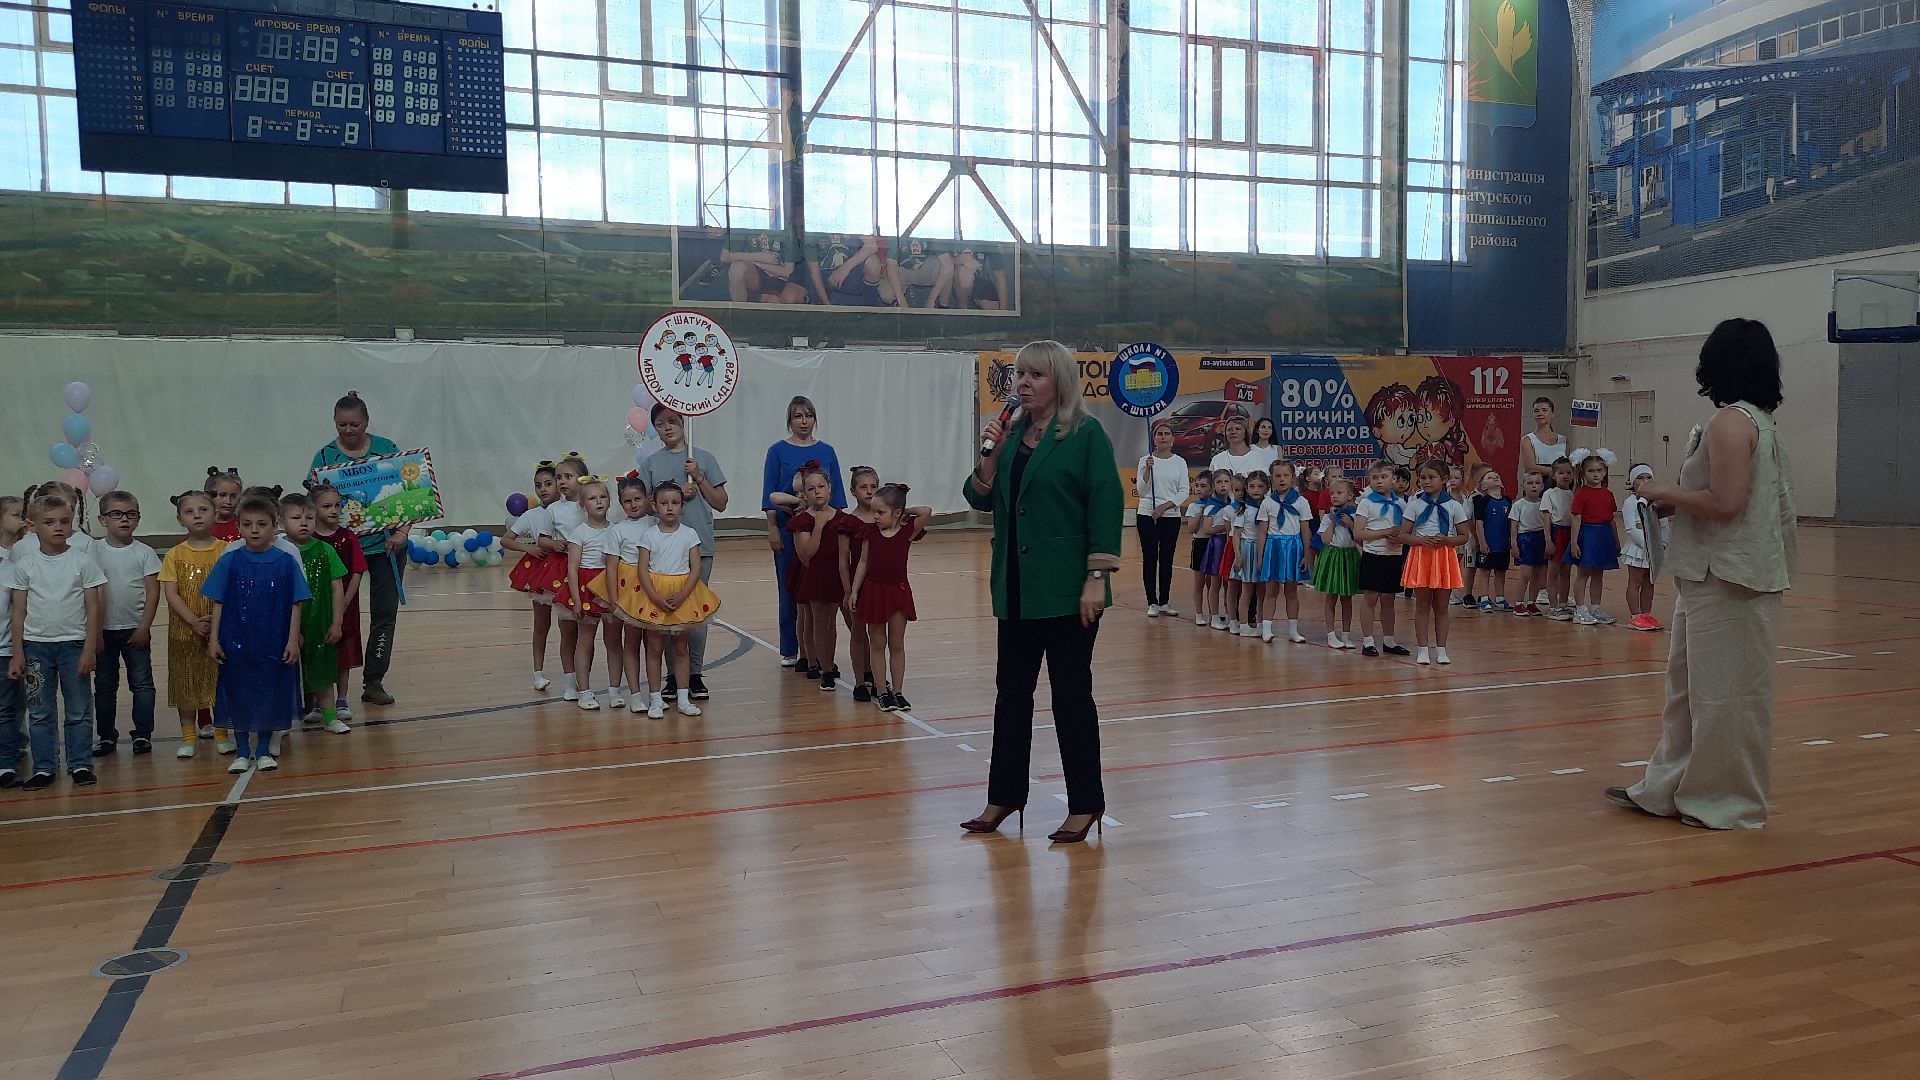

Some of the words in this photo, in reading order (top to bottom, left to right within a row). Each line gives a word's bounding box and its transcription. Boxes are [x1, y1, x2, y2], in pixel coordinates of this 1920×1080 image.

[178, 11, 214, 23] ВРЕМЯ
[254, 19, 301, 31] ИГРОВОЕ
[307, 23, 341, 34] ВРЕМЯ
[397, 32, 431, 42] ВРЕМЯ
[245, 63, 274, 73] СЧЕТ
[326, 70, 354, 80] СЧЕТ
[285, 109, 320, 119] ПЕРИОД
[1470, 233, 1518, 248] района
[1119, 344, 1151, 362] ШКОЛА
[644, 358, 664, 393] МБДОУ
[713, 385, 731, 402] САД
[1470, 366, 1510, 395] 112
[1281, 378, 1354, 409] 80%
[1130, 400, 1168, 416] ШАТУРА
[1281, 410, 1355, 424] ПРИЧИН
[1282, 426, 1370, 440] ПОЖАРОВ
[1283, 443, 1374, 456] НЕОСТОРОЖНОЕ
[342, 465, 374, 477] МБОУ
[1295, 458, 1378, 471] ОБРАЩЕНИ
